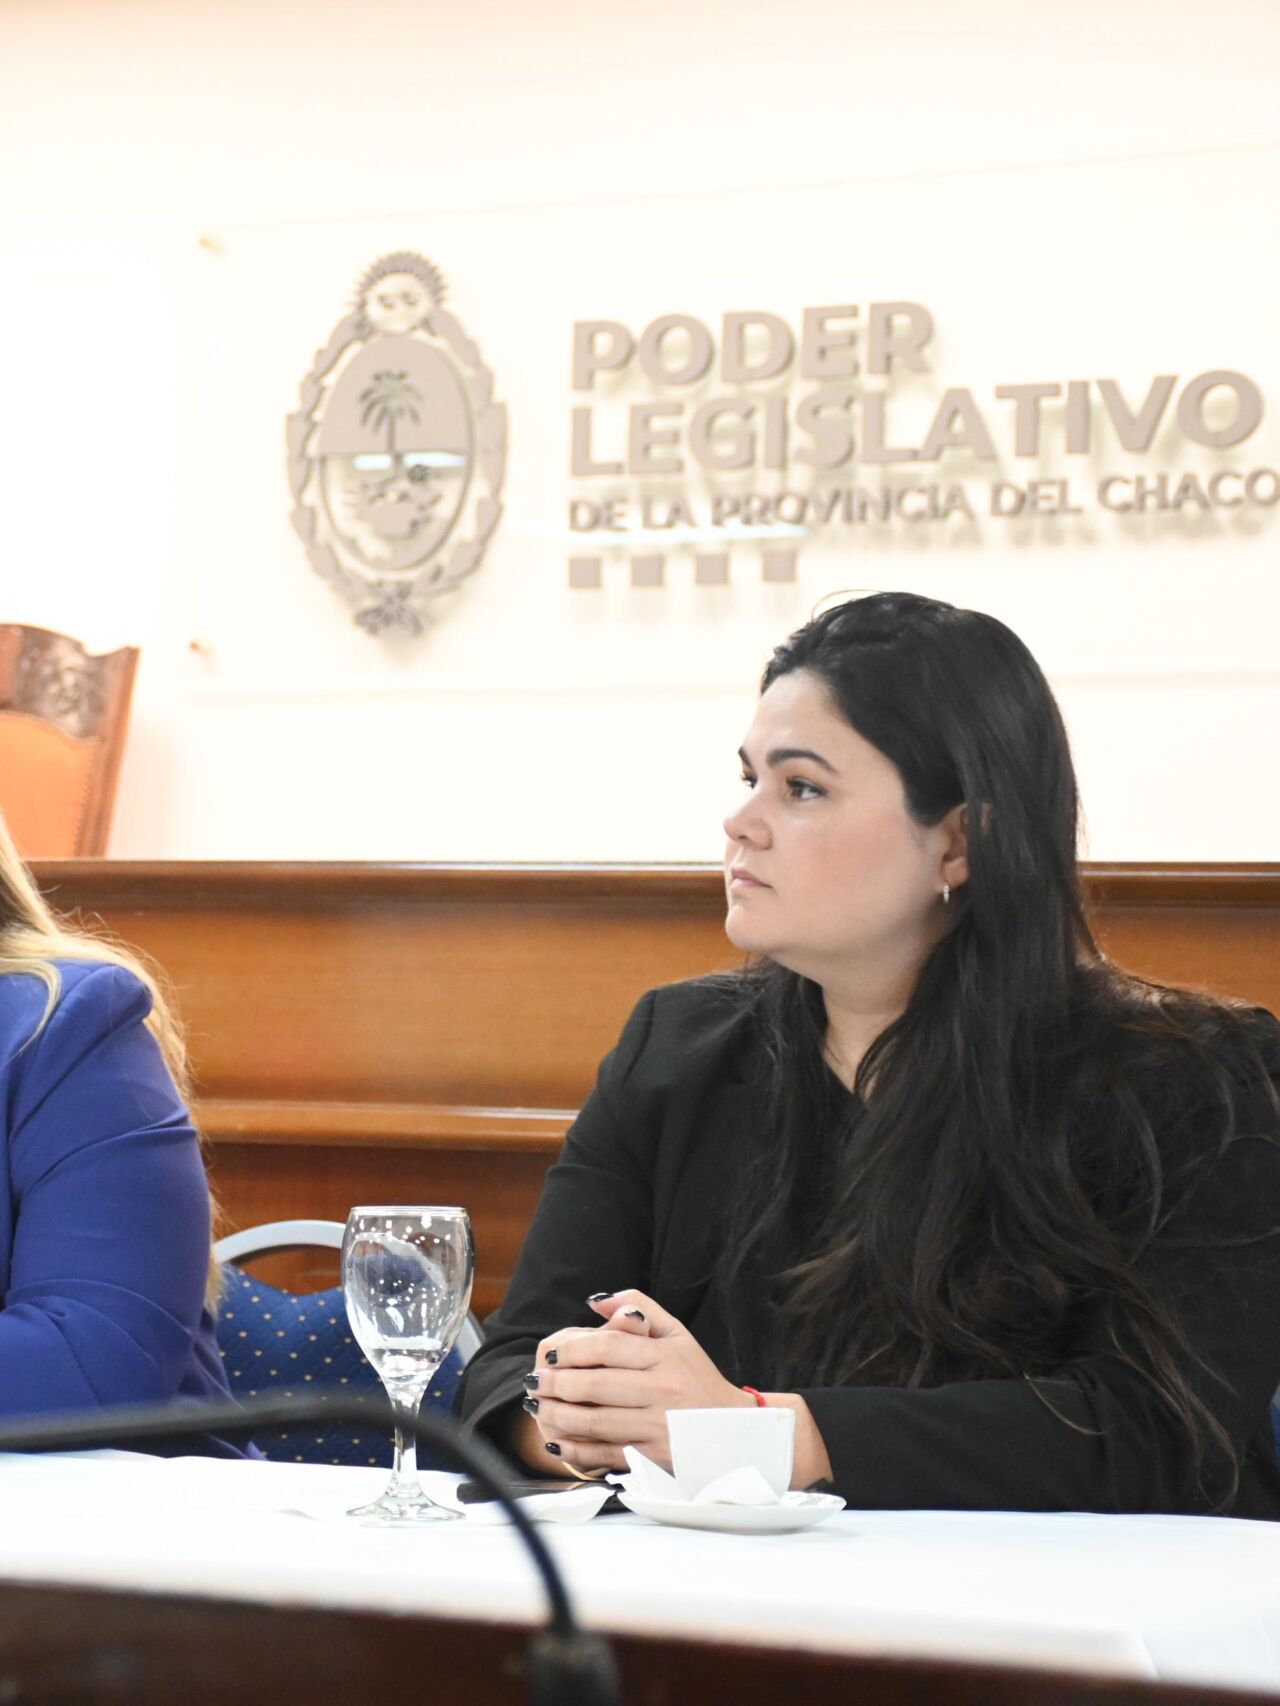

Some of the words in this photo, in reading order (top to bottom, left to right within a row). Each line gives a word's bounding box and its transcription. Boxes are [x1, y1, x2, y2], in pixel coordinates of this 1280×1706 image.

[570, 301, 935, 392] PODER
[570, 370, 1265, 477] LEGISLATIVO
[568, 499, 629, 532] DE
[642, 497, 696, 530] LA
[712, 480, 976, 528] PROVINCIA
[990, 478, 1083, 518] DEL
[1097, 468, 1280, 515] CHACO
